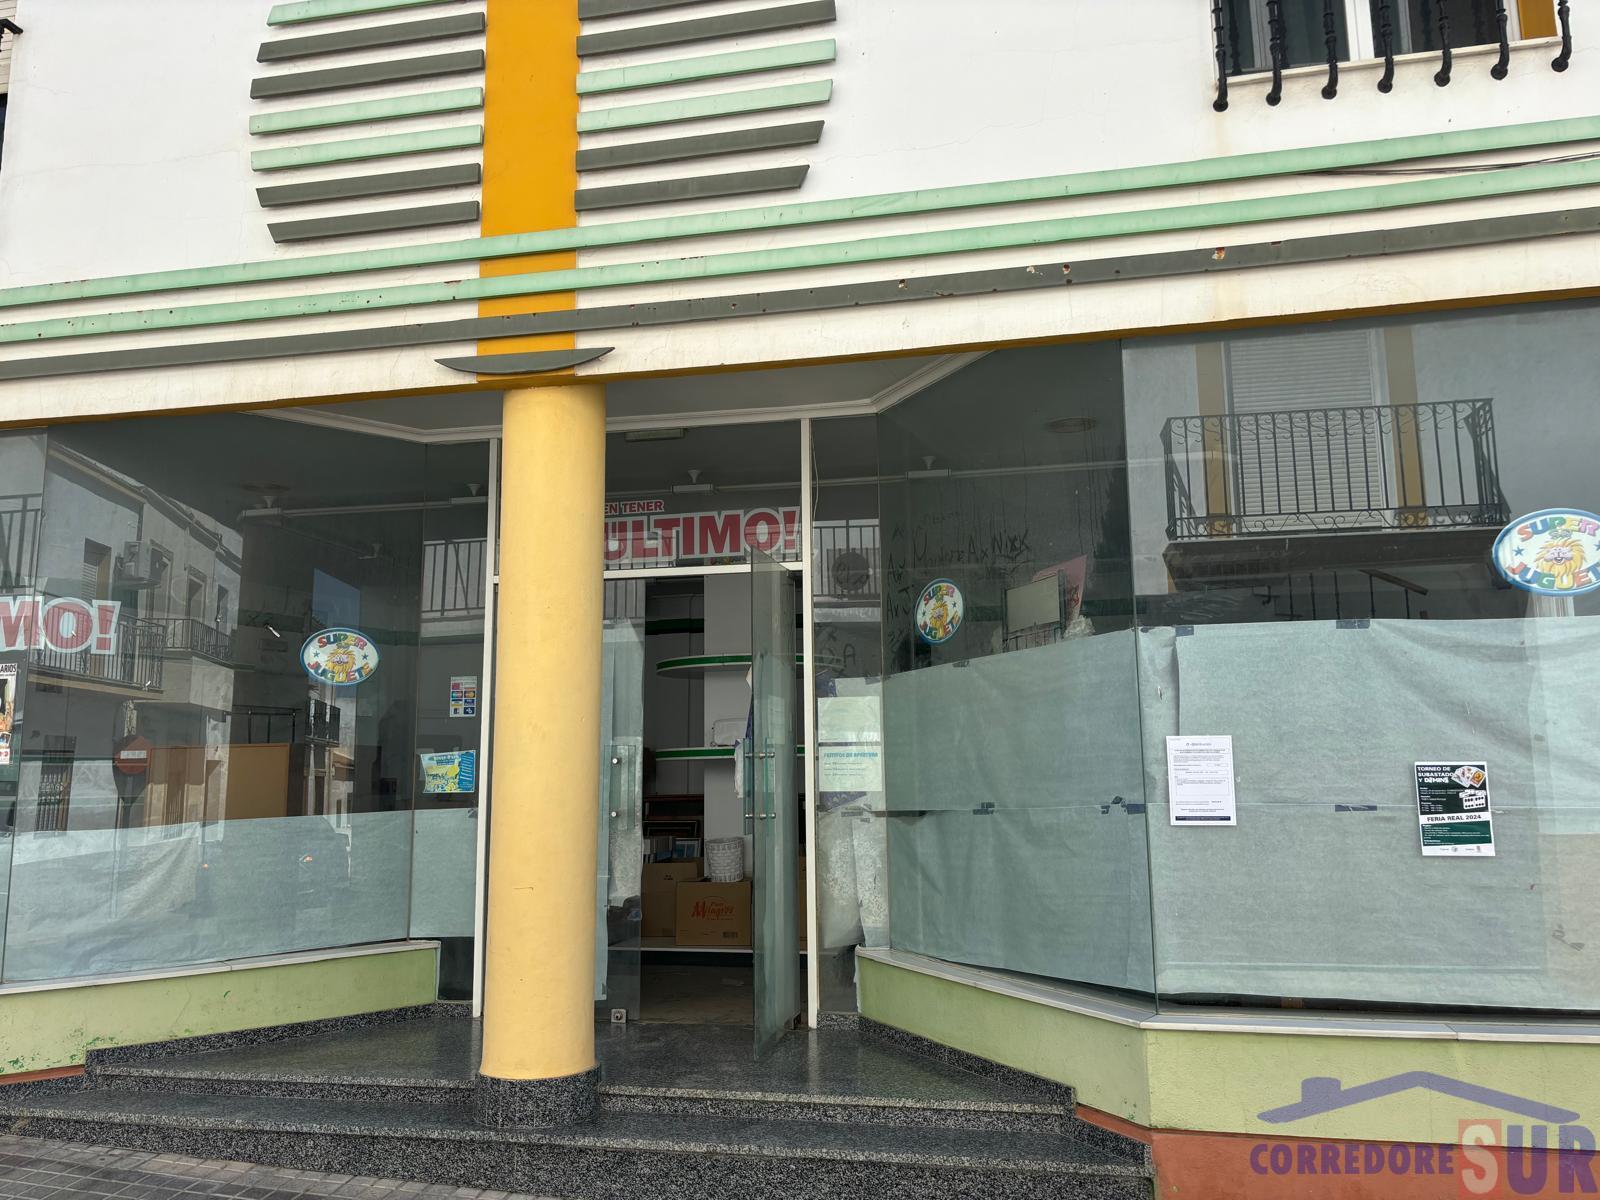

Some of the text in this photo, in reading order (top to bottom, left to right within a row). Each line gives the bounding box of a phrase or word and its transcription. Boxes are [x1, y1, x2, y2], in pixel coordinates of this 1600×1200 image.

[622, 500, 664, 513] TENER
[1517, 516, 1599, 541] SUPER
[1506, 562, 1600, 588] JUGUET
[923, 584, 956, 606] SUPER
[919, 609, 962, 640] JUGUETE
[317, 633, 368, 650] SUPER
[307, 660, 373, 682] JUGUETE
